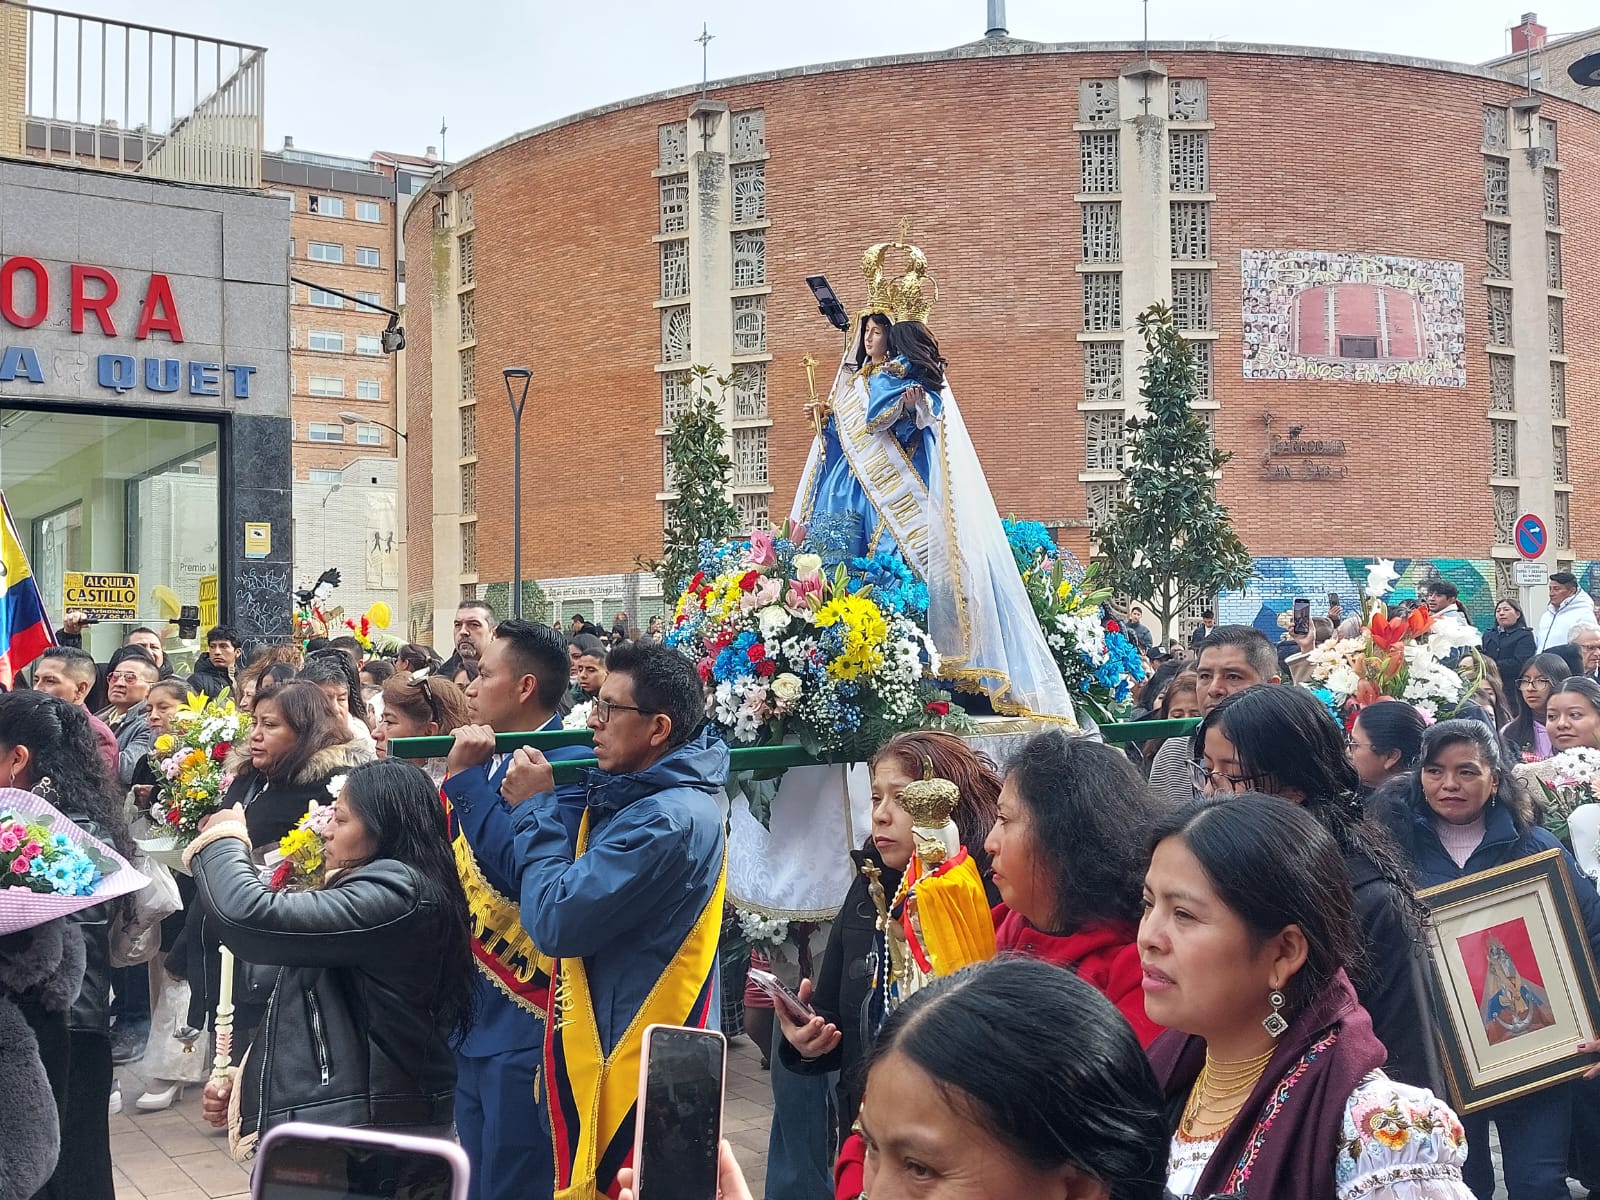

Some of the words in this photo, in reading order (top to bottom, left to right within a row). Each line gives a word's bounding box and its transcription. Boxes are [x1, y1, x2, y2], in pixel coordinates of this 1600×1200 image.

[0, 256, 184, 343] ORA
[1255, 346, 1290, 368] 50
[1297, 358, 1345, 378] AÑOS
[1355, 366, 1376, 382] EN
[887, 491, 922, 528] DEL
[180, 563, 207, 572] Premio
[86, 576, 134, 588] ALQUILA
[66, 588, 136, 603] CASTILLO
